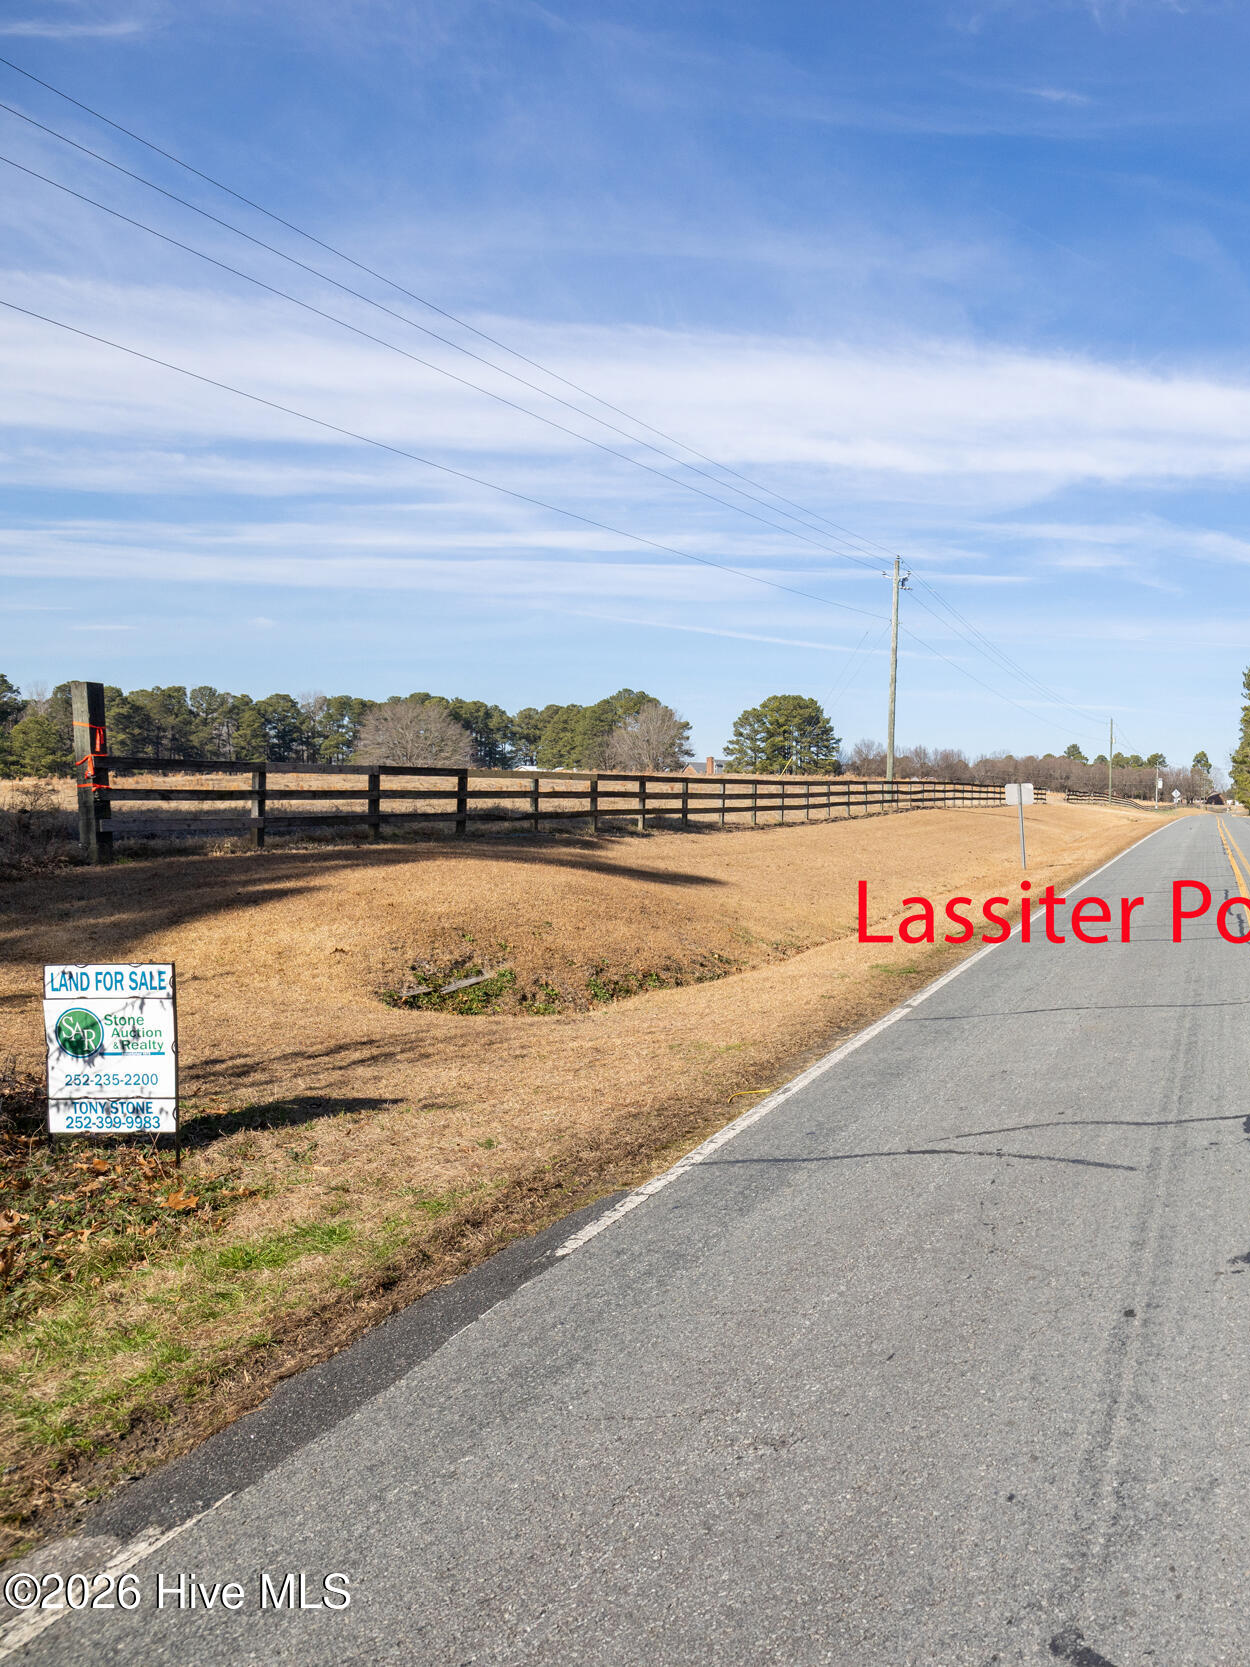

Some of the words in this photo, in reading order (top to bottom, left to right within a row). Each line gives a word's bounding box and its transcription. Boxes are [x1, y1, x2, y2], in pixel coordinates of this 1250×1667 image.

[51, 972, 90, 992] LAND
[95, 972, 124, 991] FOR
[129, 971, 167, 991] SALE
[104, 1014, 144, 1026] Stone
[61, 1016, 96, 1050] SAR
[112, 1028, 162, 1038] Auction
[121, 1040, 164, 1052] Realty
[65, 1074, 159, 1086] 252-235-2200
[73, 1102, 107, 1115] TONY
[110, 1101, 153, 1115] STONE
[65, 1116, 161, 1129] 252-399-9983
